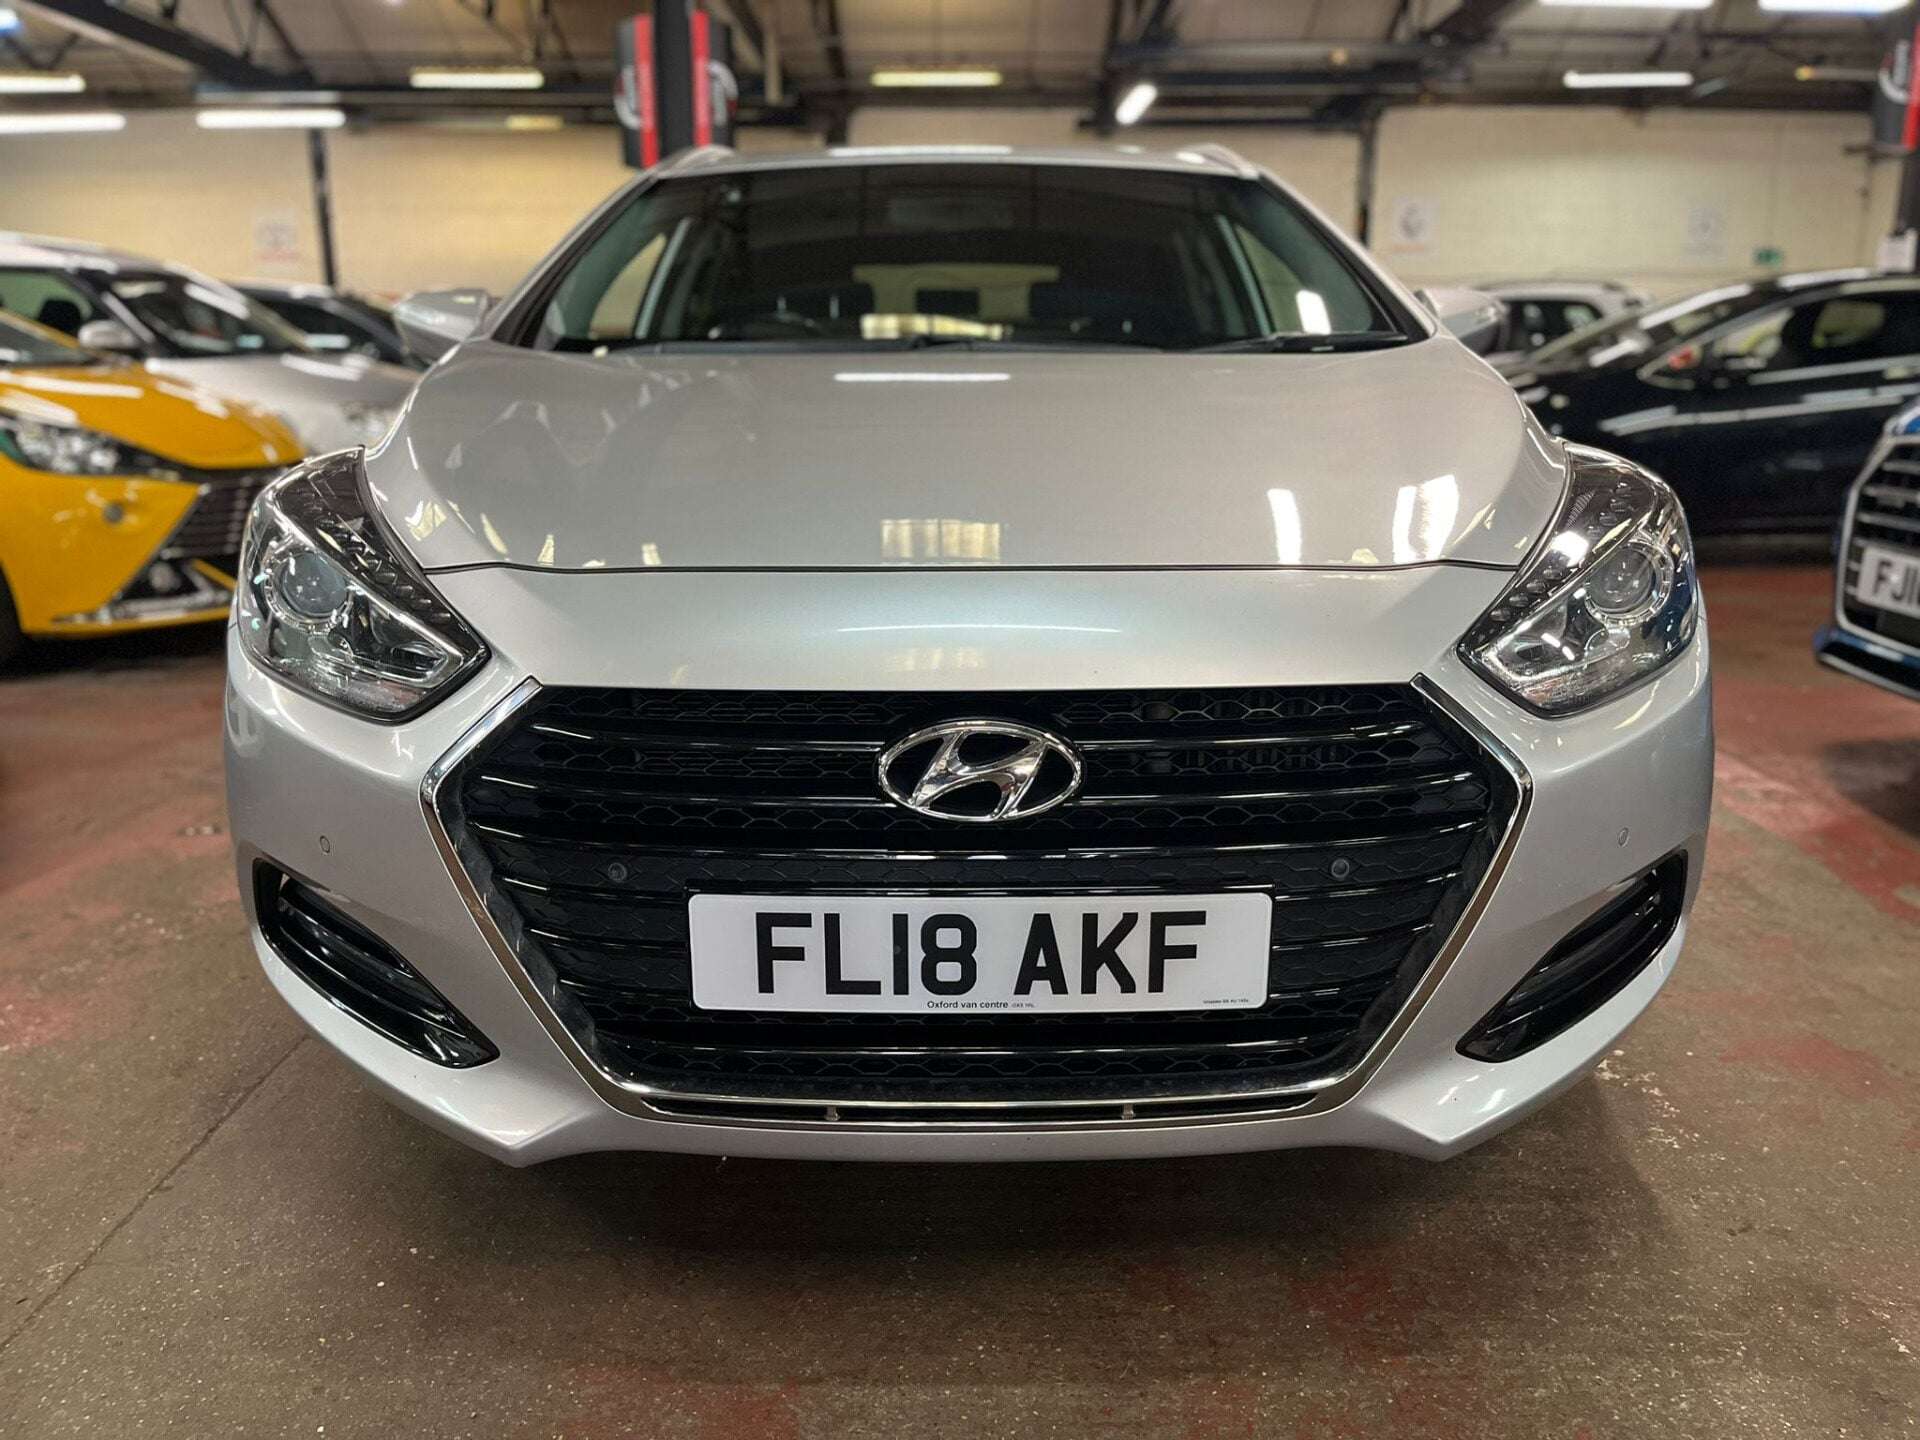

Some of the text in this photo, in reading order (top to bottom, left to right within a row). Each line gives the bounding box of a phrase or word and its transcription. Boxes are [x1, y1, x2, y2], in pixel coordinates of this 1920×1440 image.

[755, 910, 1207, 996] FL18 AKF
[926, 1000, 959, 1009] Oxford
[979, 1001, 1009, 1009] centre
